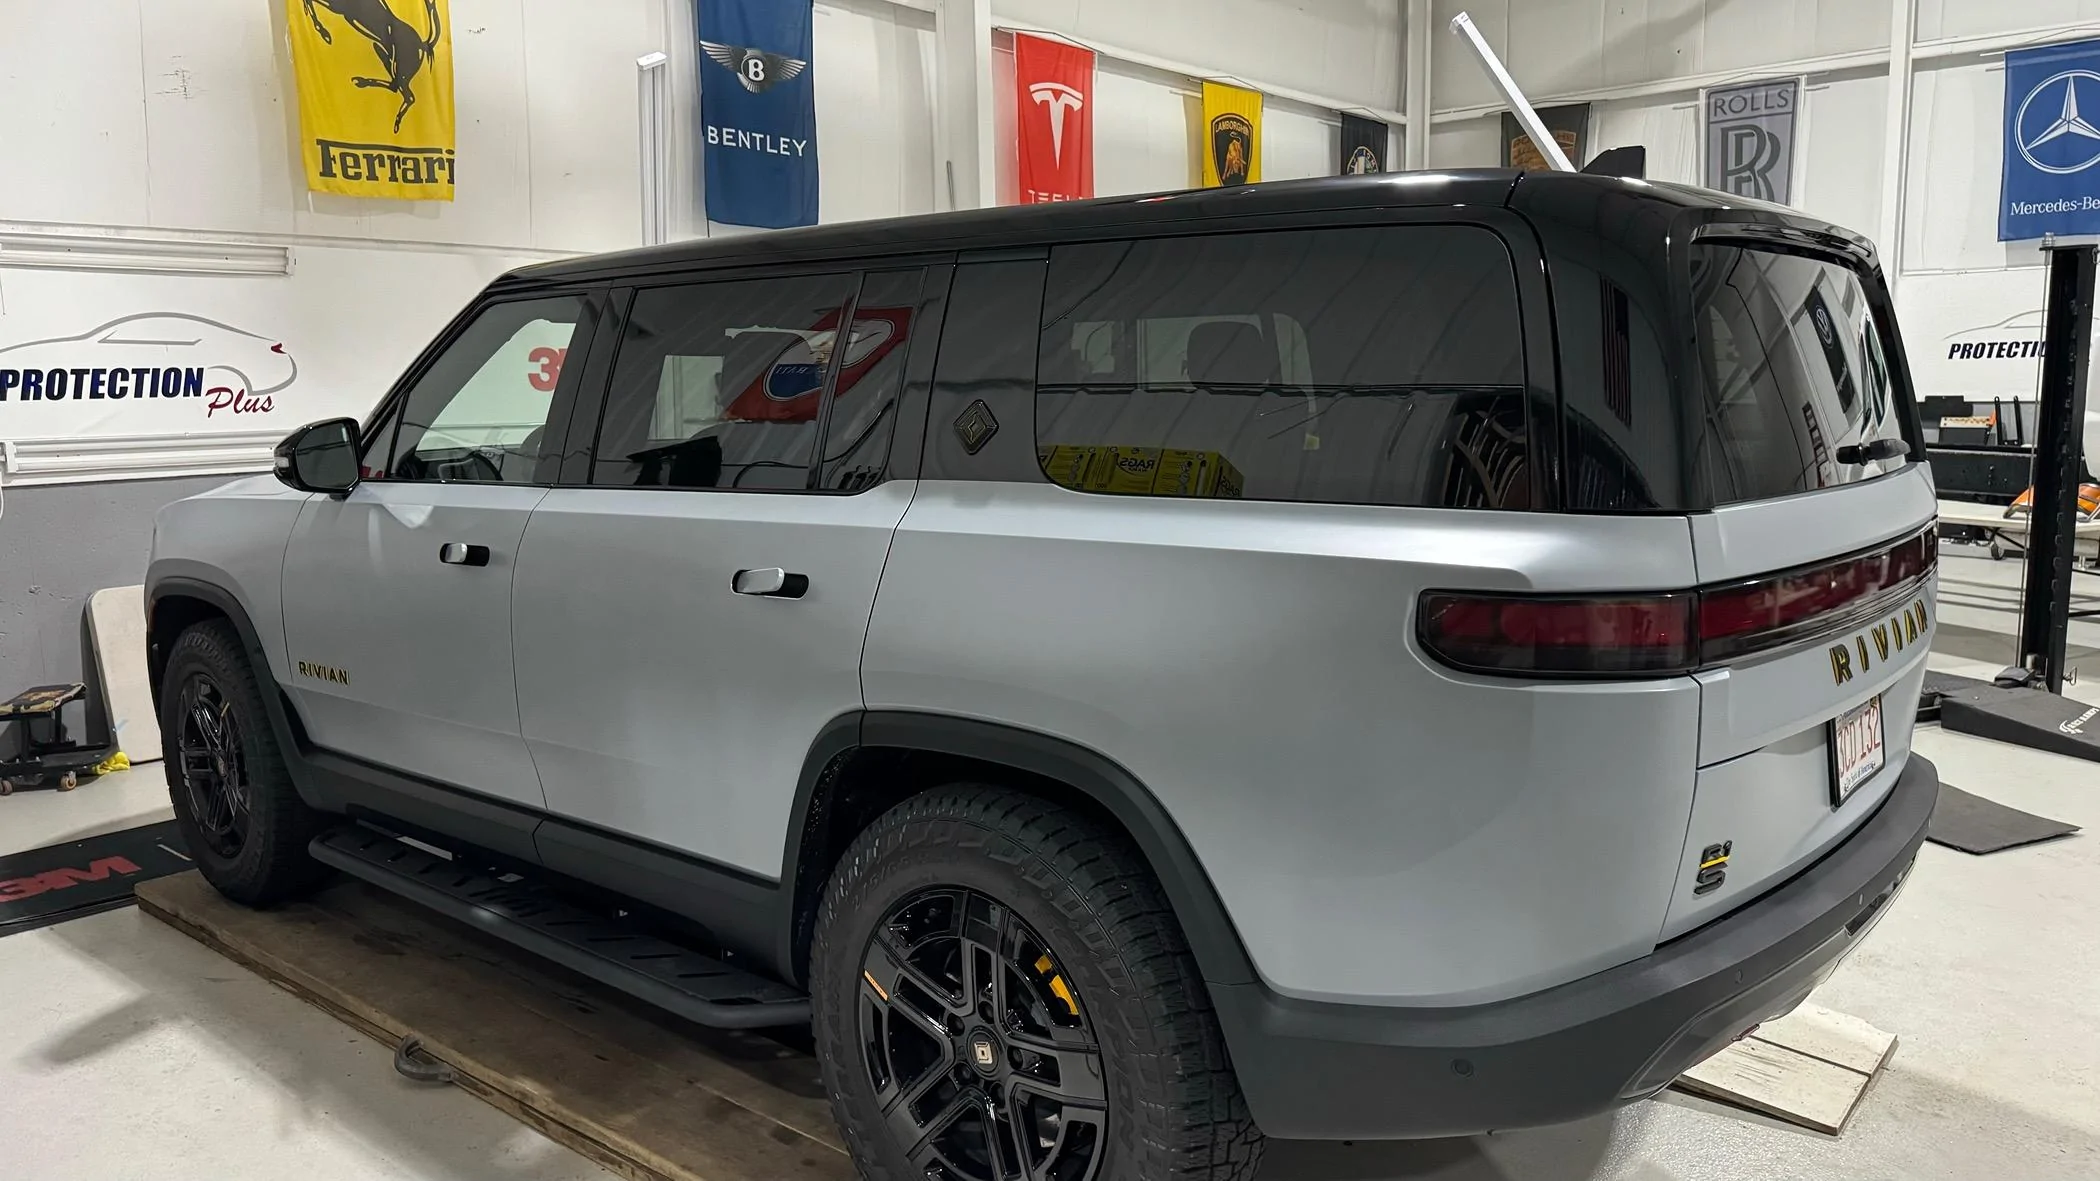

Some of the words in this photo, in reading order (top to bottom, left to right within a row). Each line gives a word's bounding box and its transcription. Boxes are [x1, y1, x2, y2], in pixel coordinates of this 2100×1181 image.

[1714, 89, 1789, 117] ROLLS
[707, 125, 807, 157] BENTLEY
[1216, 120, 1249, 136] LAMBORGH
[316, 138, 455, 185] Ferrari
[1028, 189, 1083, 204] TES
[0, 367, 204, 402] PROTECTION
[205, 386, 274, 418] Plus
[1829, 599, 1928, 687] RIVIAN
[298, 660, 351, 686] RIVIAN
[1859, 704, 1881, 760] 132
[0, 855, 142, 903] 3M
